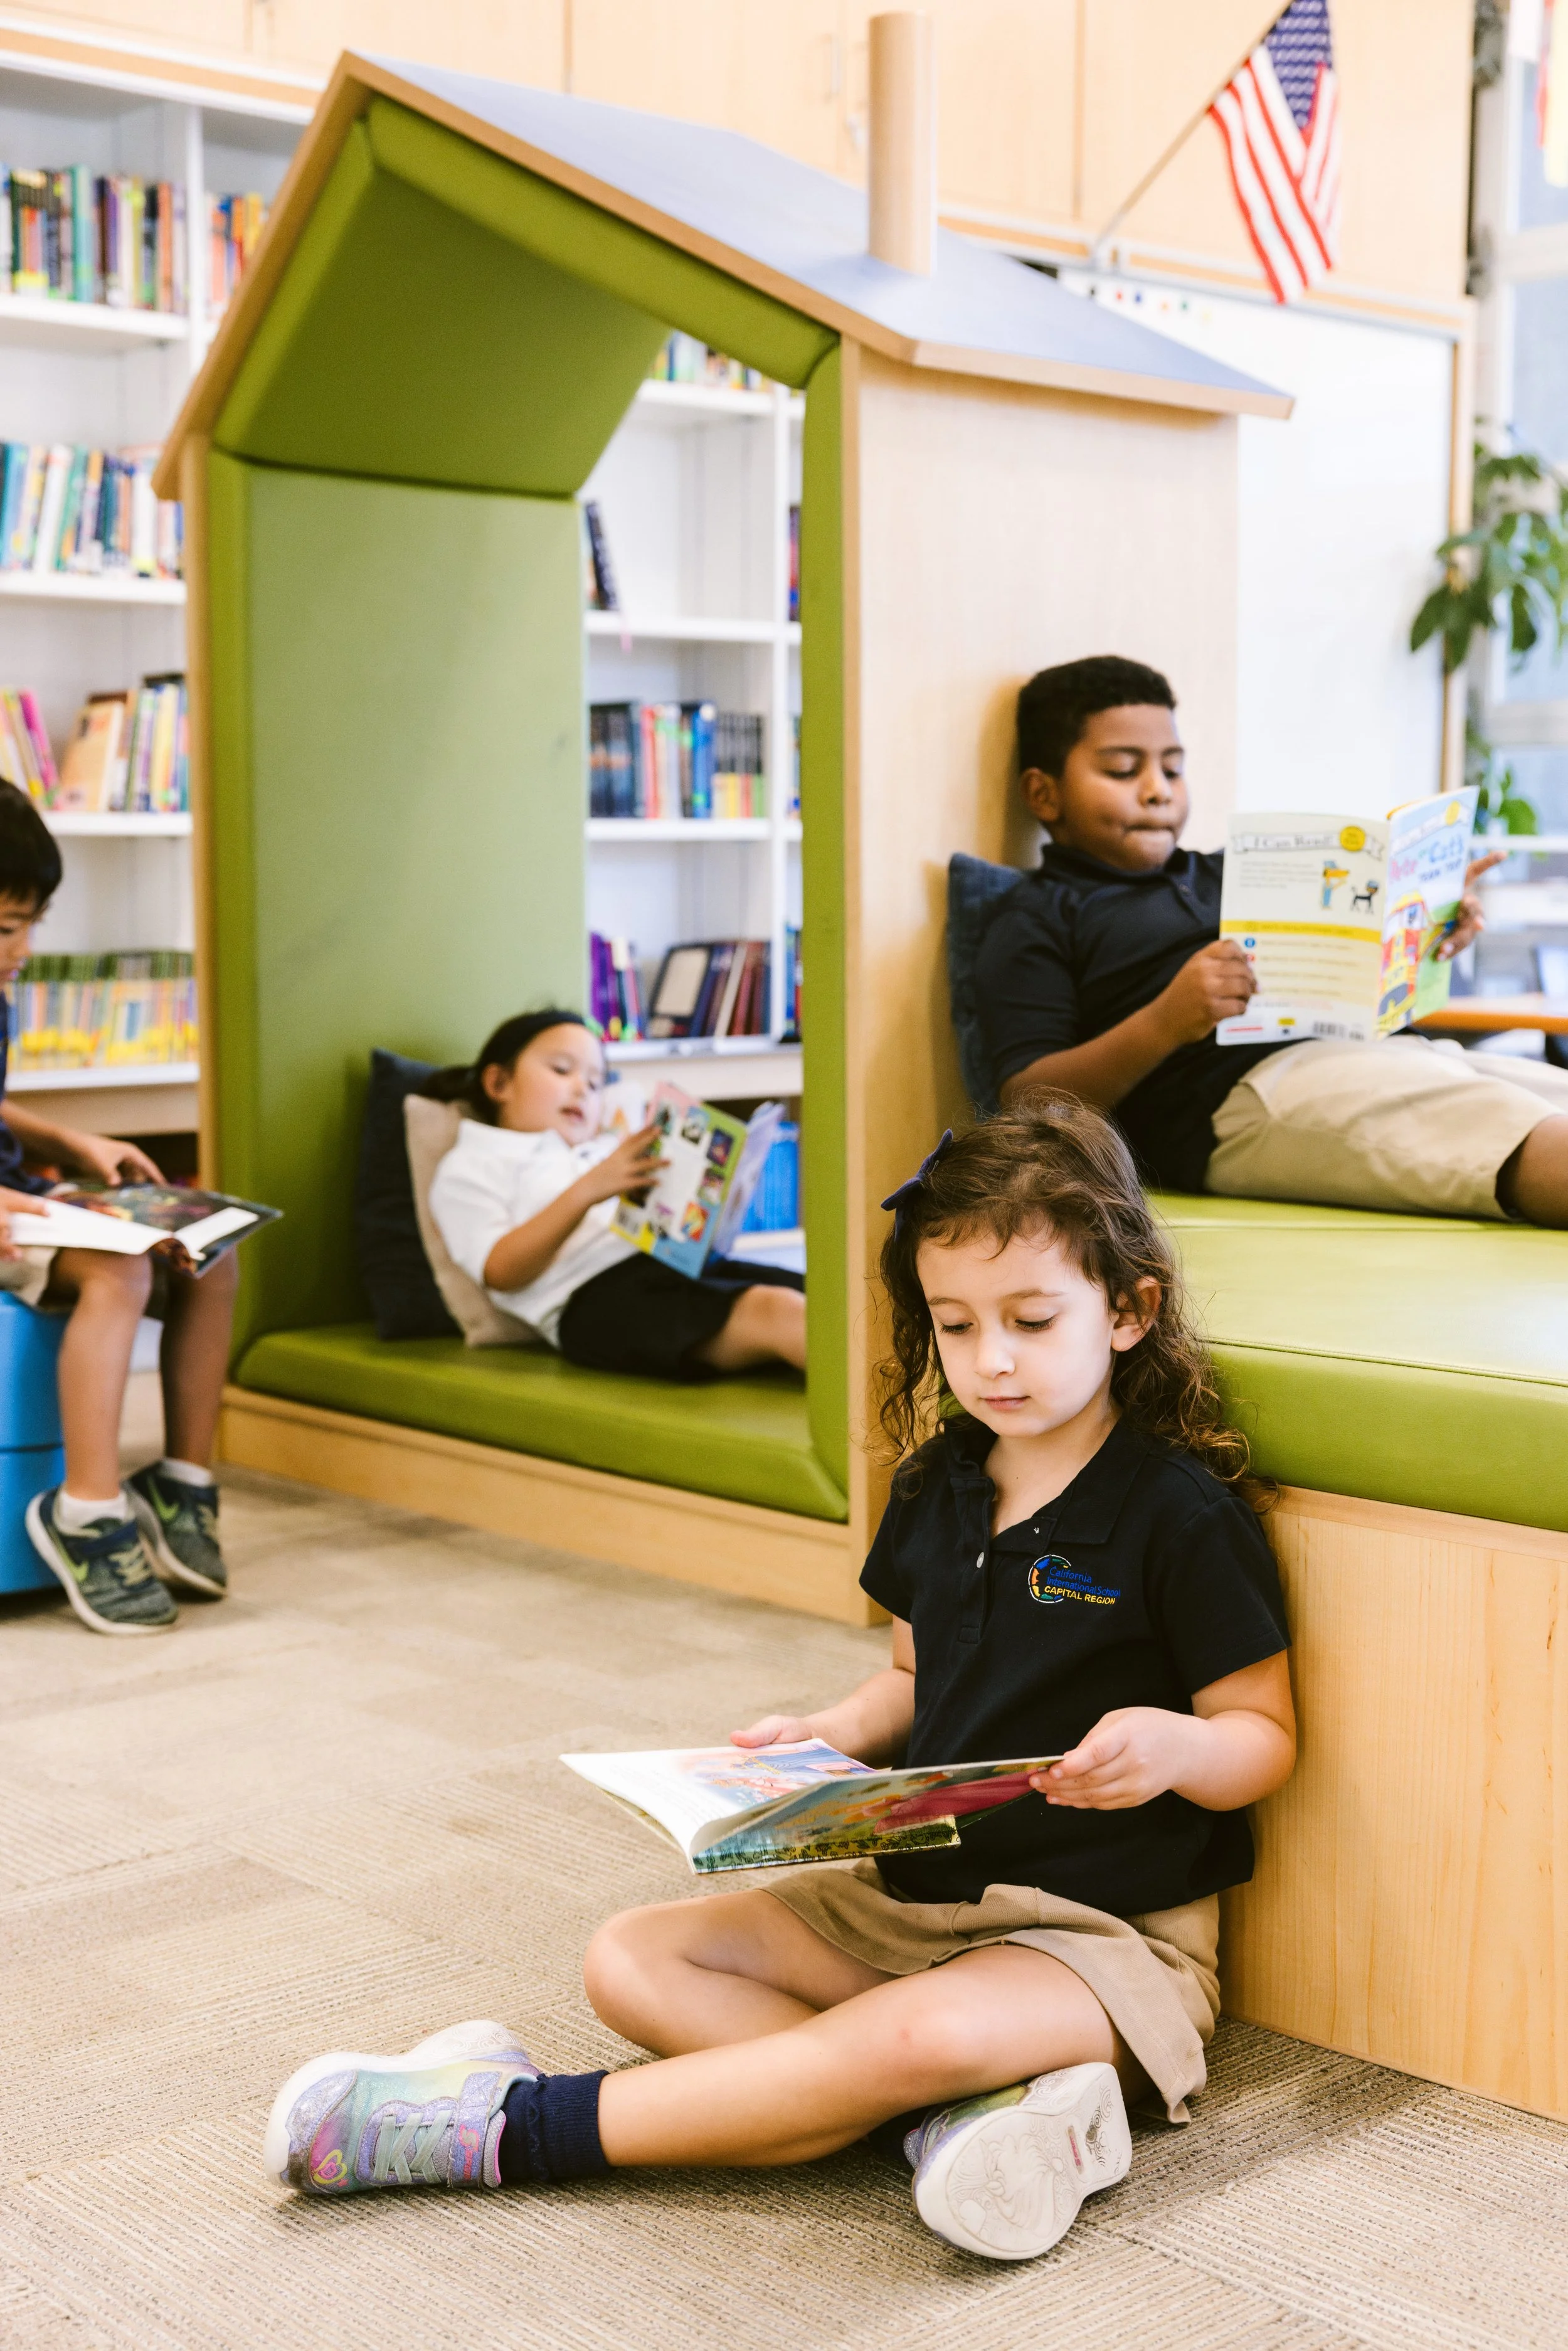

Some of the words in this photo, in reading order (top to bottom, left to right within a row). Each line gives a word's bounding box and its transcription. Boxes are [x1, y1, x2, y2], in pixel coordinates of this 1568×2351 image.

[1049, 1566, 1092, 1583] California
[1044, 1586, 1082, 1600] CAPITAL
[1084, 1594, 1116, 1605] REGION
[1046, 1576, 1096, 1595] International
[1098, 1586, 1121, 1597] School
